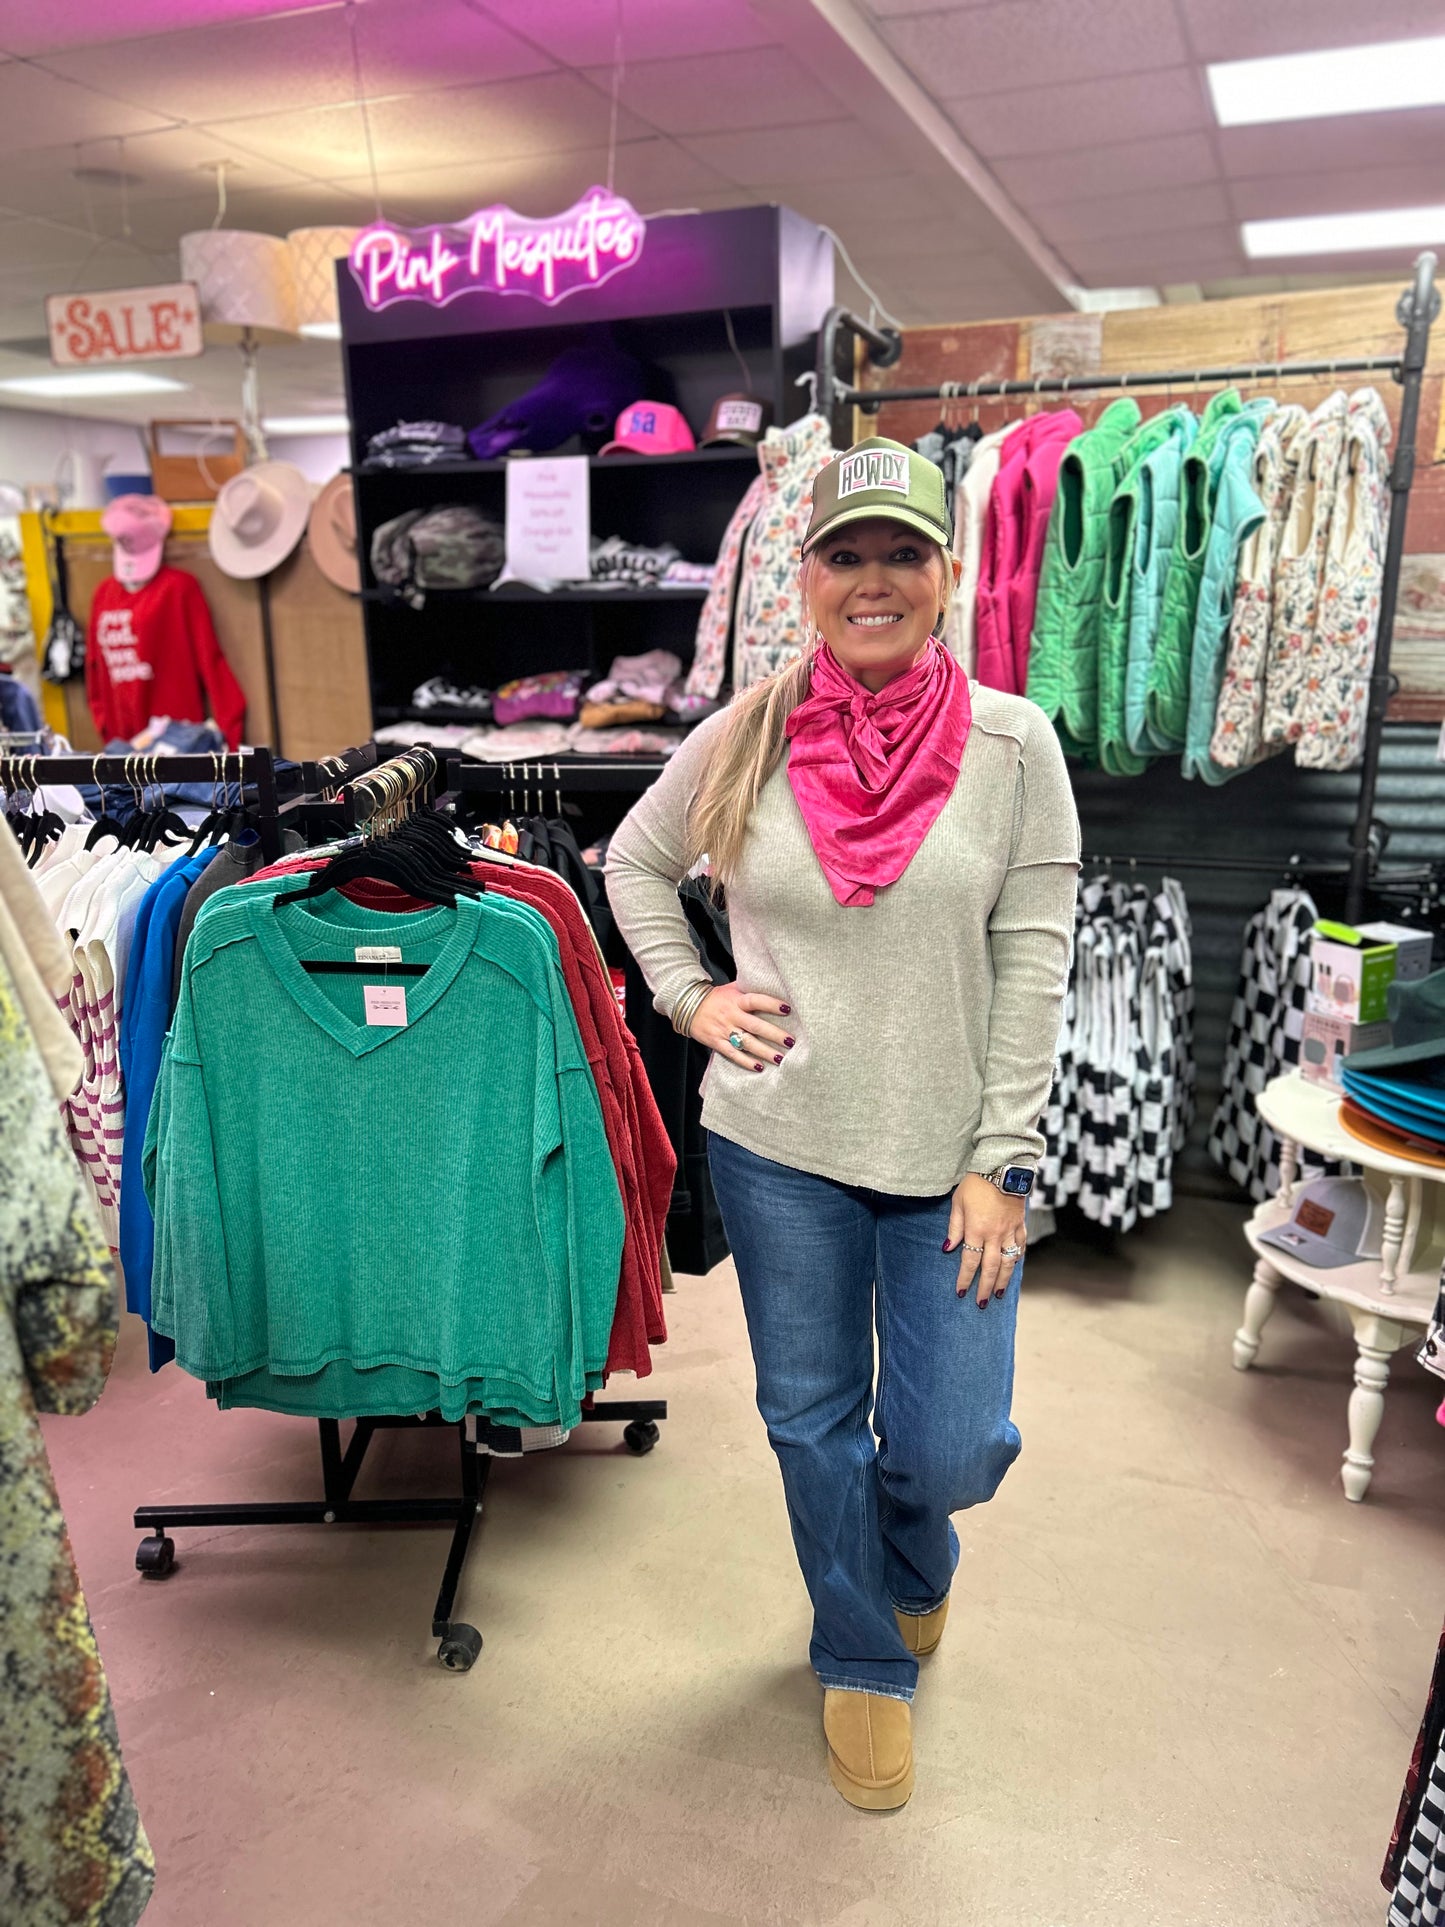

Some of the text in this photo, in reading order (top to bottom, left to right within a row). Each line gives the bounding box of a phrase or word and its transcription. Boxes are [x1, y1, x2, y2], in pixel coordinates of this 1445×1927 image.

[353, 194, 638, 305] Pink Mesquites
[66, 299, 181, 360] SALE
[842, 453, 904, 495] HOWDY
